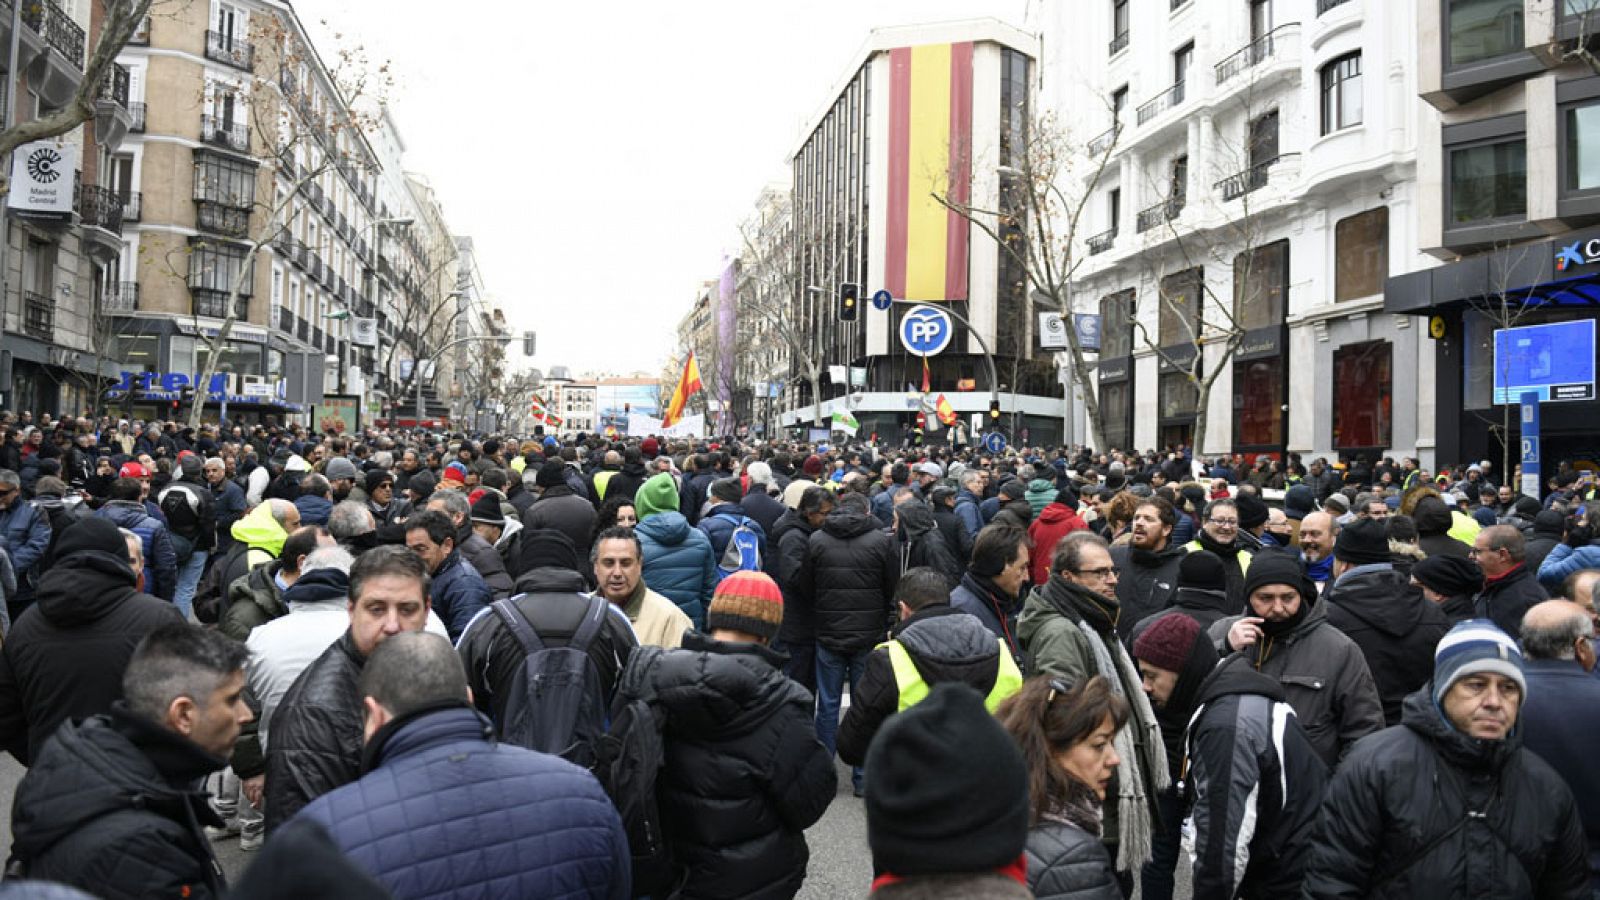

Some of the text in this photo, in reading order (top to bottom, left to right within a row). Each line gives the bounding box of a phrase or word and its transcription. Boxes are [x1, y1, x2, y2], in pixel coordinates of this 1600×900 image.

[30, 187, 57, 196] Madrid
[28, 196, 57, 205] Central
[911, 321, 940, 343] PP
